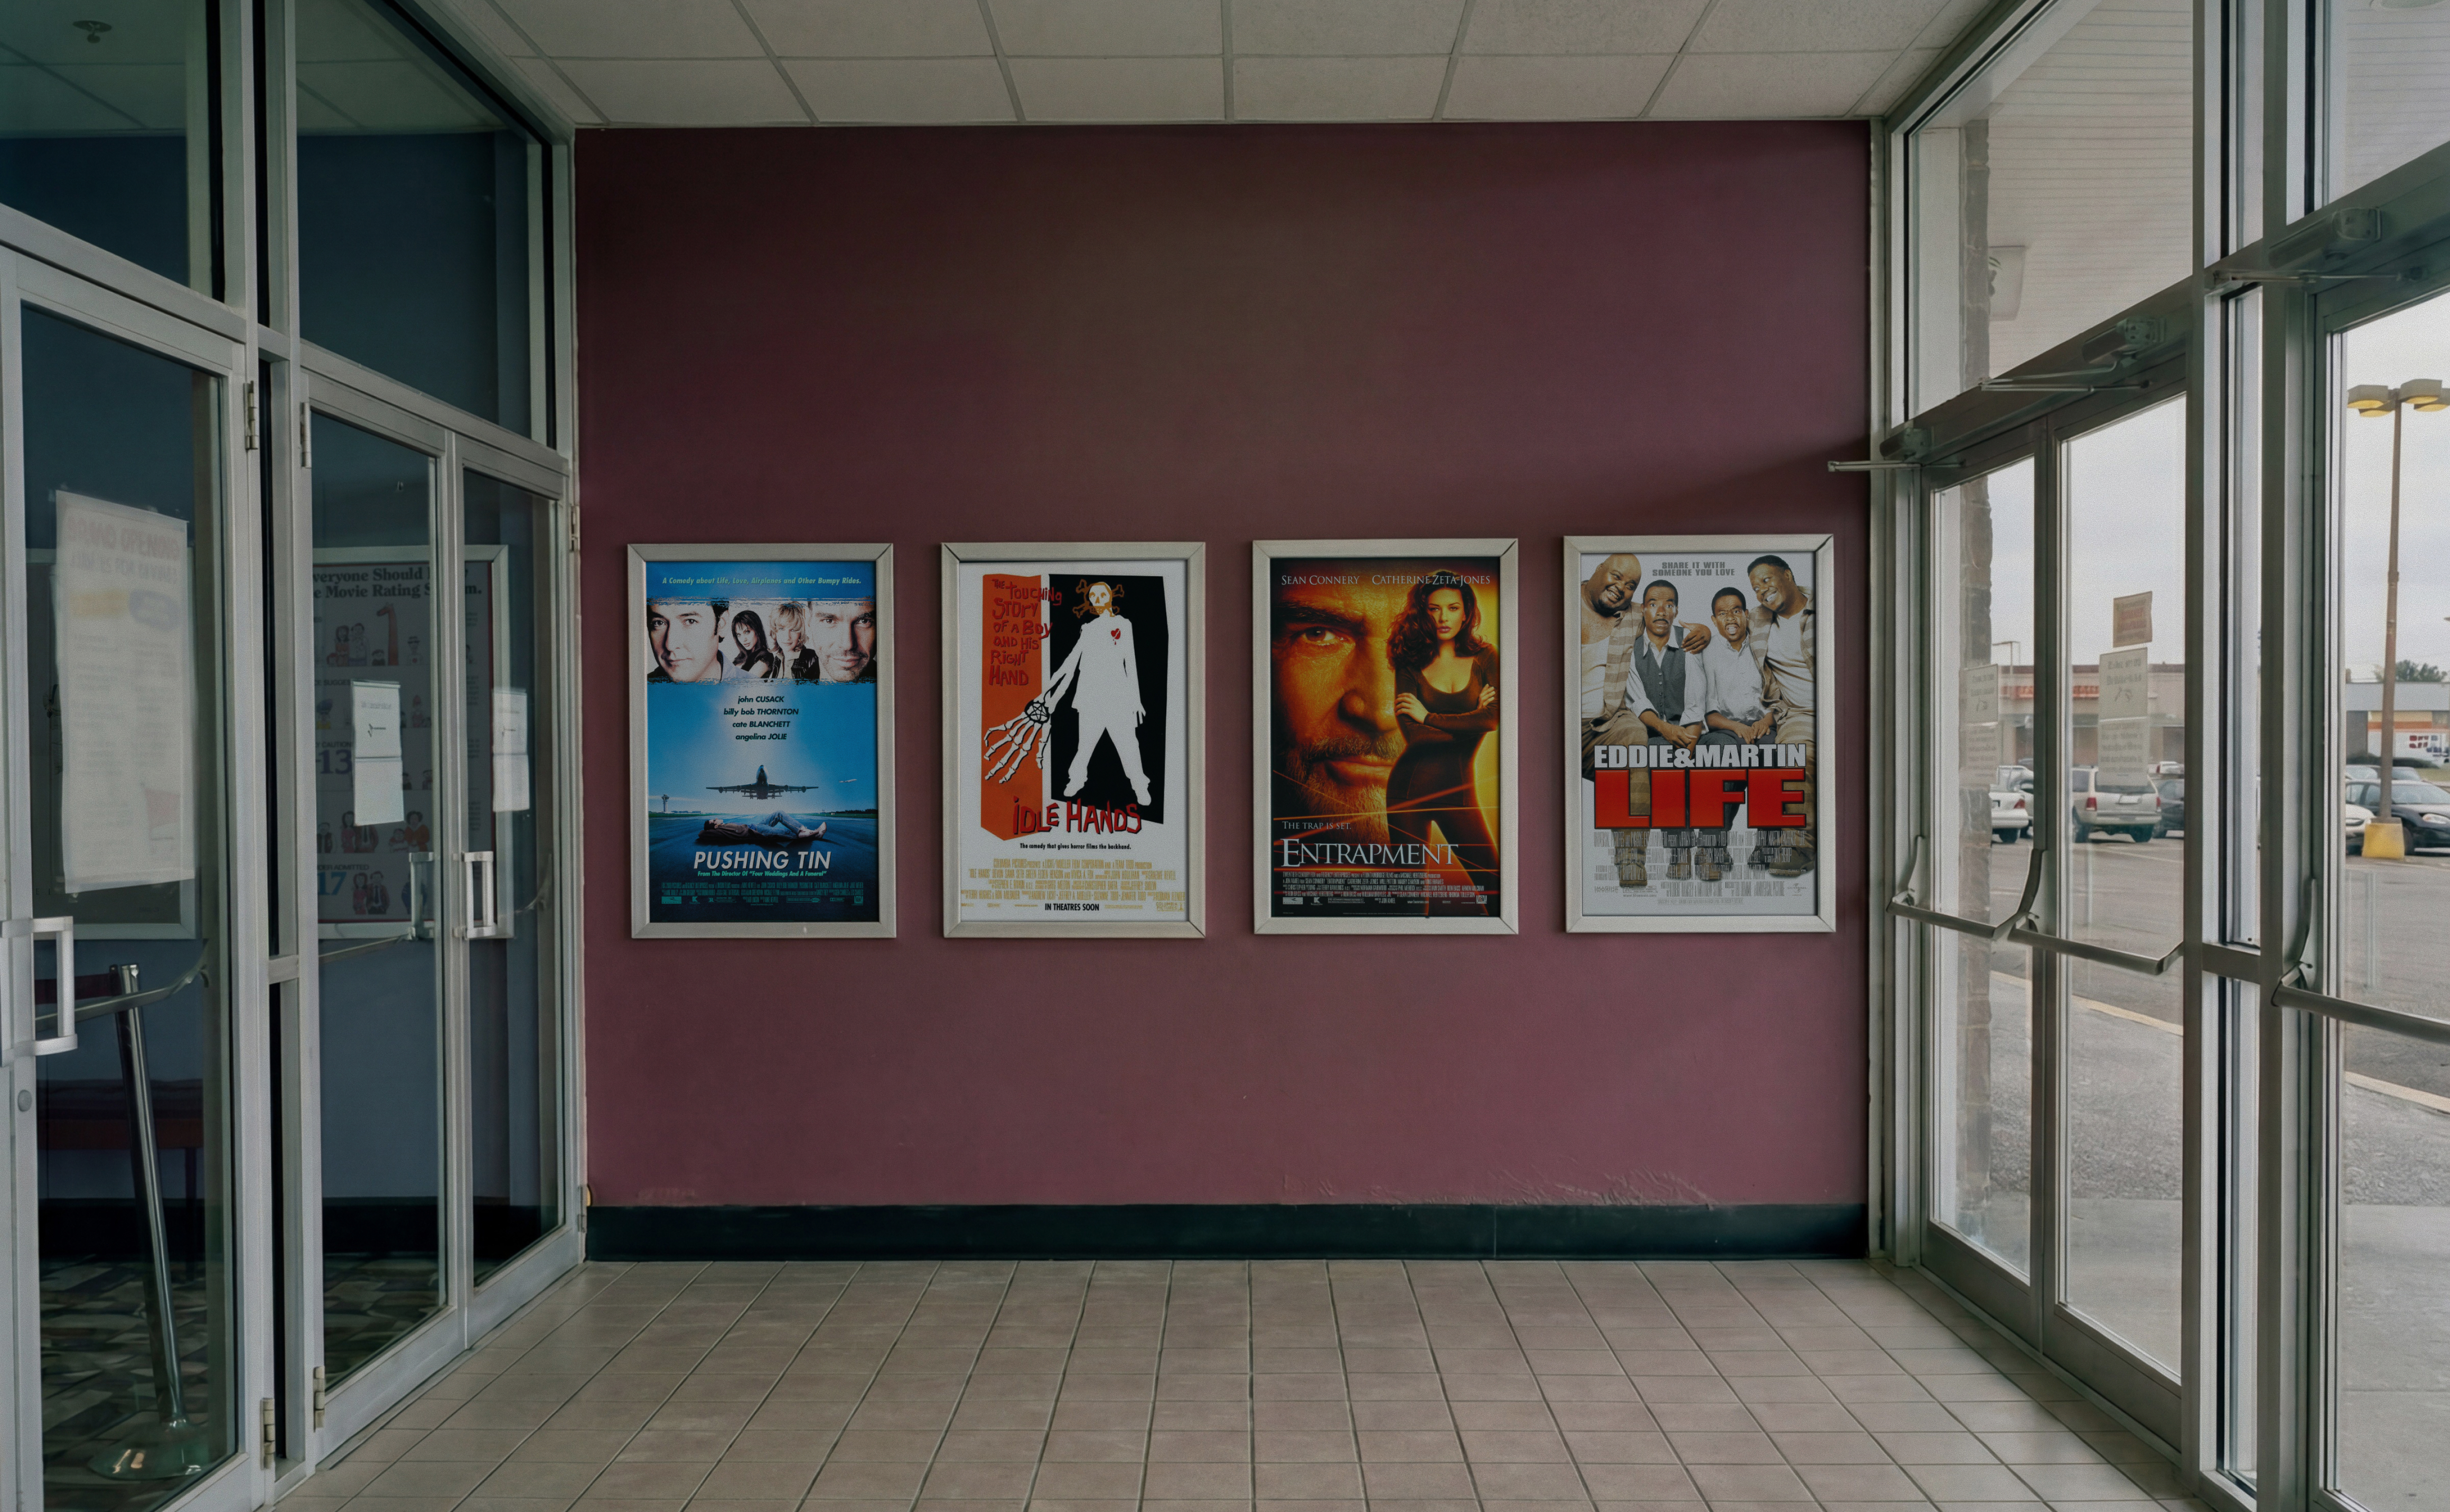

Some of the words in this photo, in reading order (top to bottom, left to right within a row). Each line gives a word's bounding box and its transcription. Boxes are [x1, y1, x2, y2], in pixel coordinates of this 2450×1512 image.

[312, 571, 369, 585] veryone
[373, 568, 422, 581] Should
[1282, 575, 1306, 585] SEAN
[1309, 575, 1360, 585] CONNERY
[1372, 575, 1431, 585] CATHERINE
[1432, 576, 1490, 587] ZETA-JONES
[992, 579, 1005, 589] THE
[325, 585, 368, 598] Movie
[372, 583, 421, 599] Rating
[993, 620, 1008, 633] OF
[1011, 624, 1020, 633] A
[989, 665, 1028, 686] HAND
[738, 696, 753, 704] john
[724, 708, 739, 717] billy
[735, 733, 766, 741] angelina
[1594, 768, 1807, 829] LIFE
[1066, 798, 1142, 834] HANDS
[1282, 821, 1300, 830] THE
[1280, 838, 1458, 867] ENTRAPMENT
[694, 851, 789, 869] PUSHING
[798, 851, 831, 869] TIN
[1045, 903, 1052, 912] IN
[1053, 903, 1081, 912] THEATRES
[1082, 903, 1099, 912] SOON
